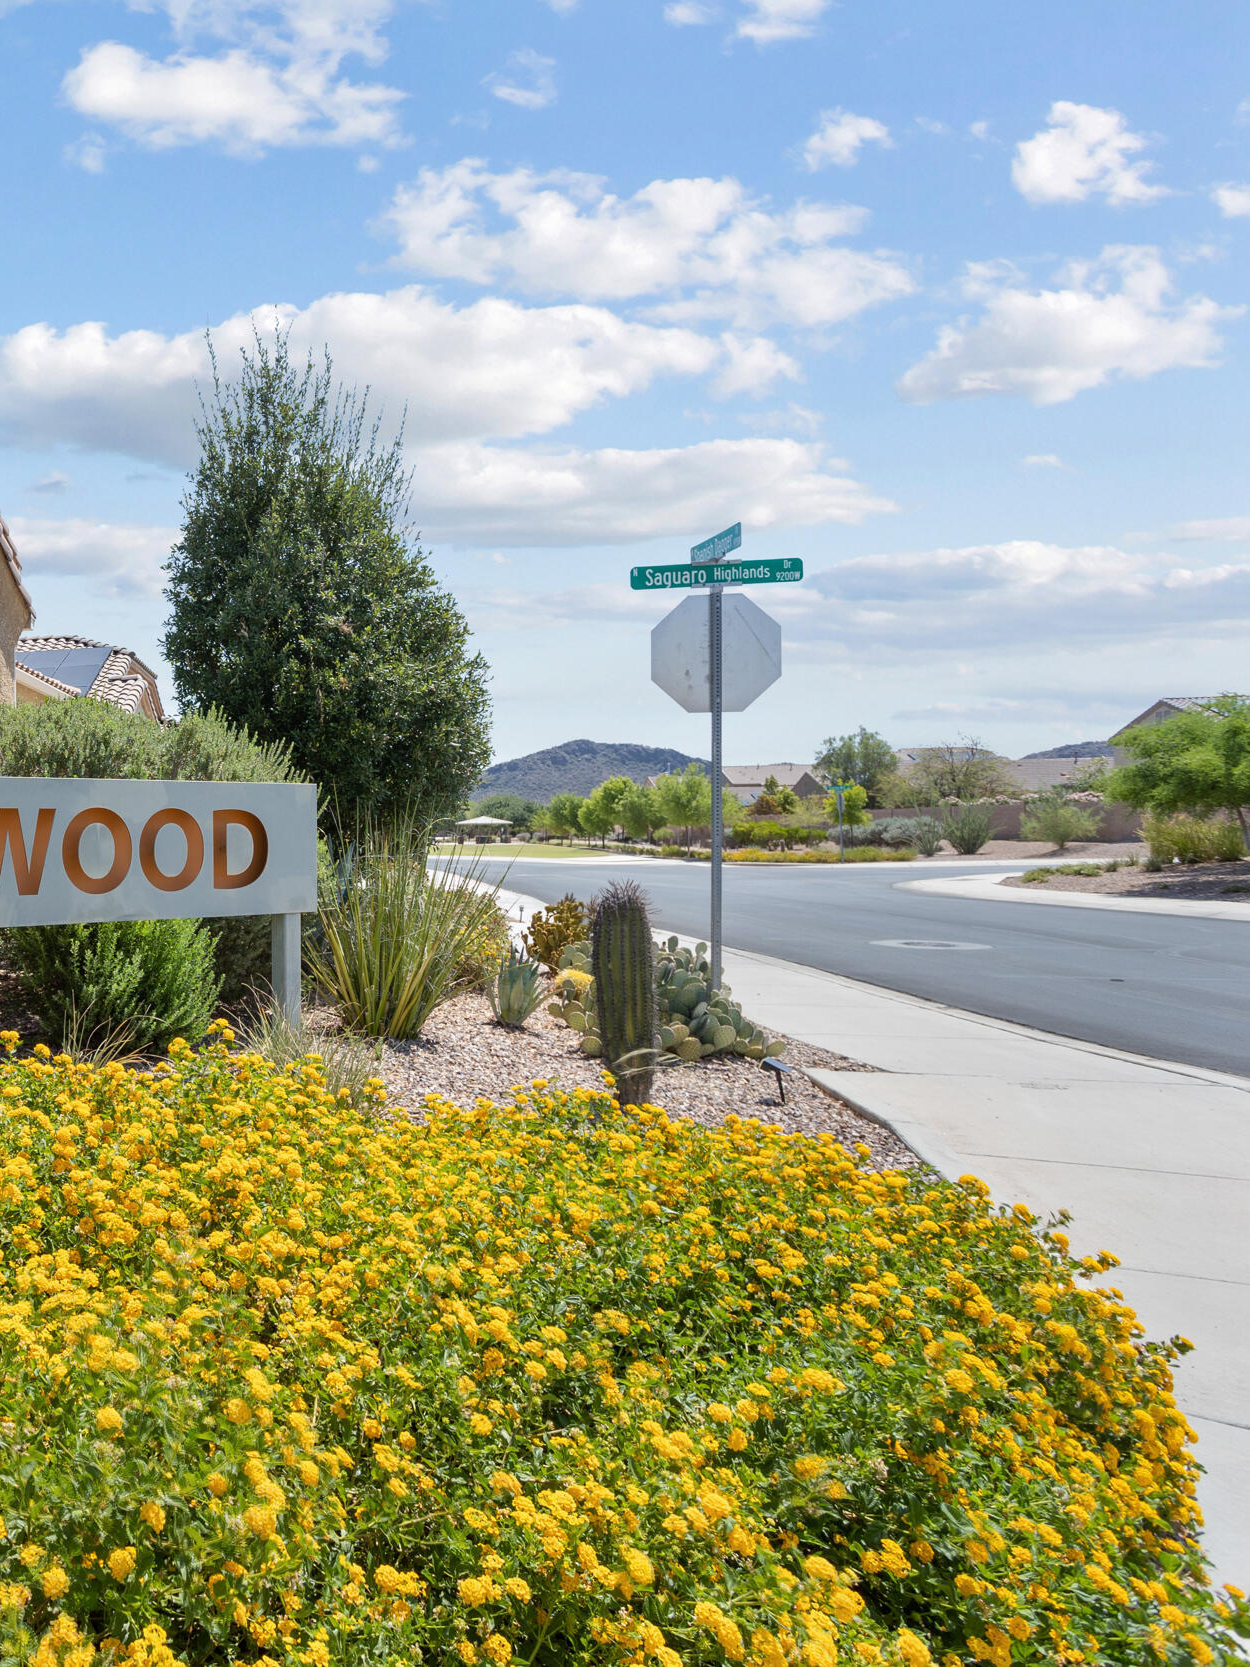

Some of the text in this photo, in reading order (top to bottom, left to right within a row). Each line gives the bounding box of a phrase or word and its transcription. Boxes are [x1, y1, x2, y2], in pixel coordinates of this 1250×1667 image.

[632, 560, 792, 588] N Saguaro Highlands Dr
